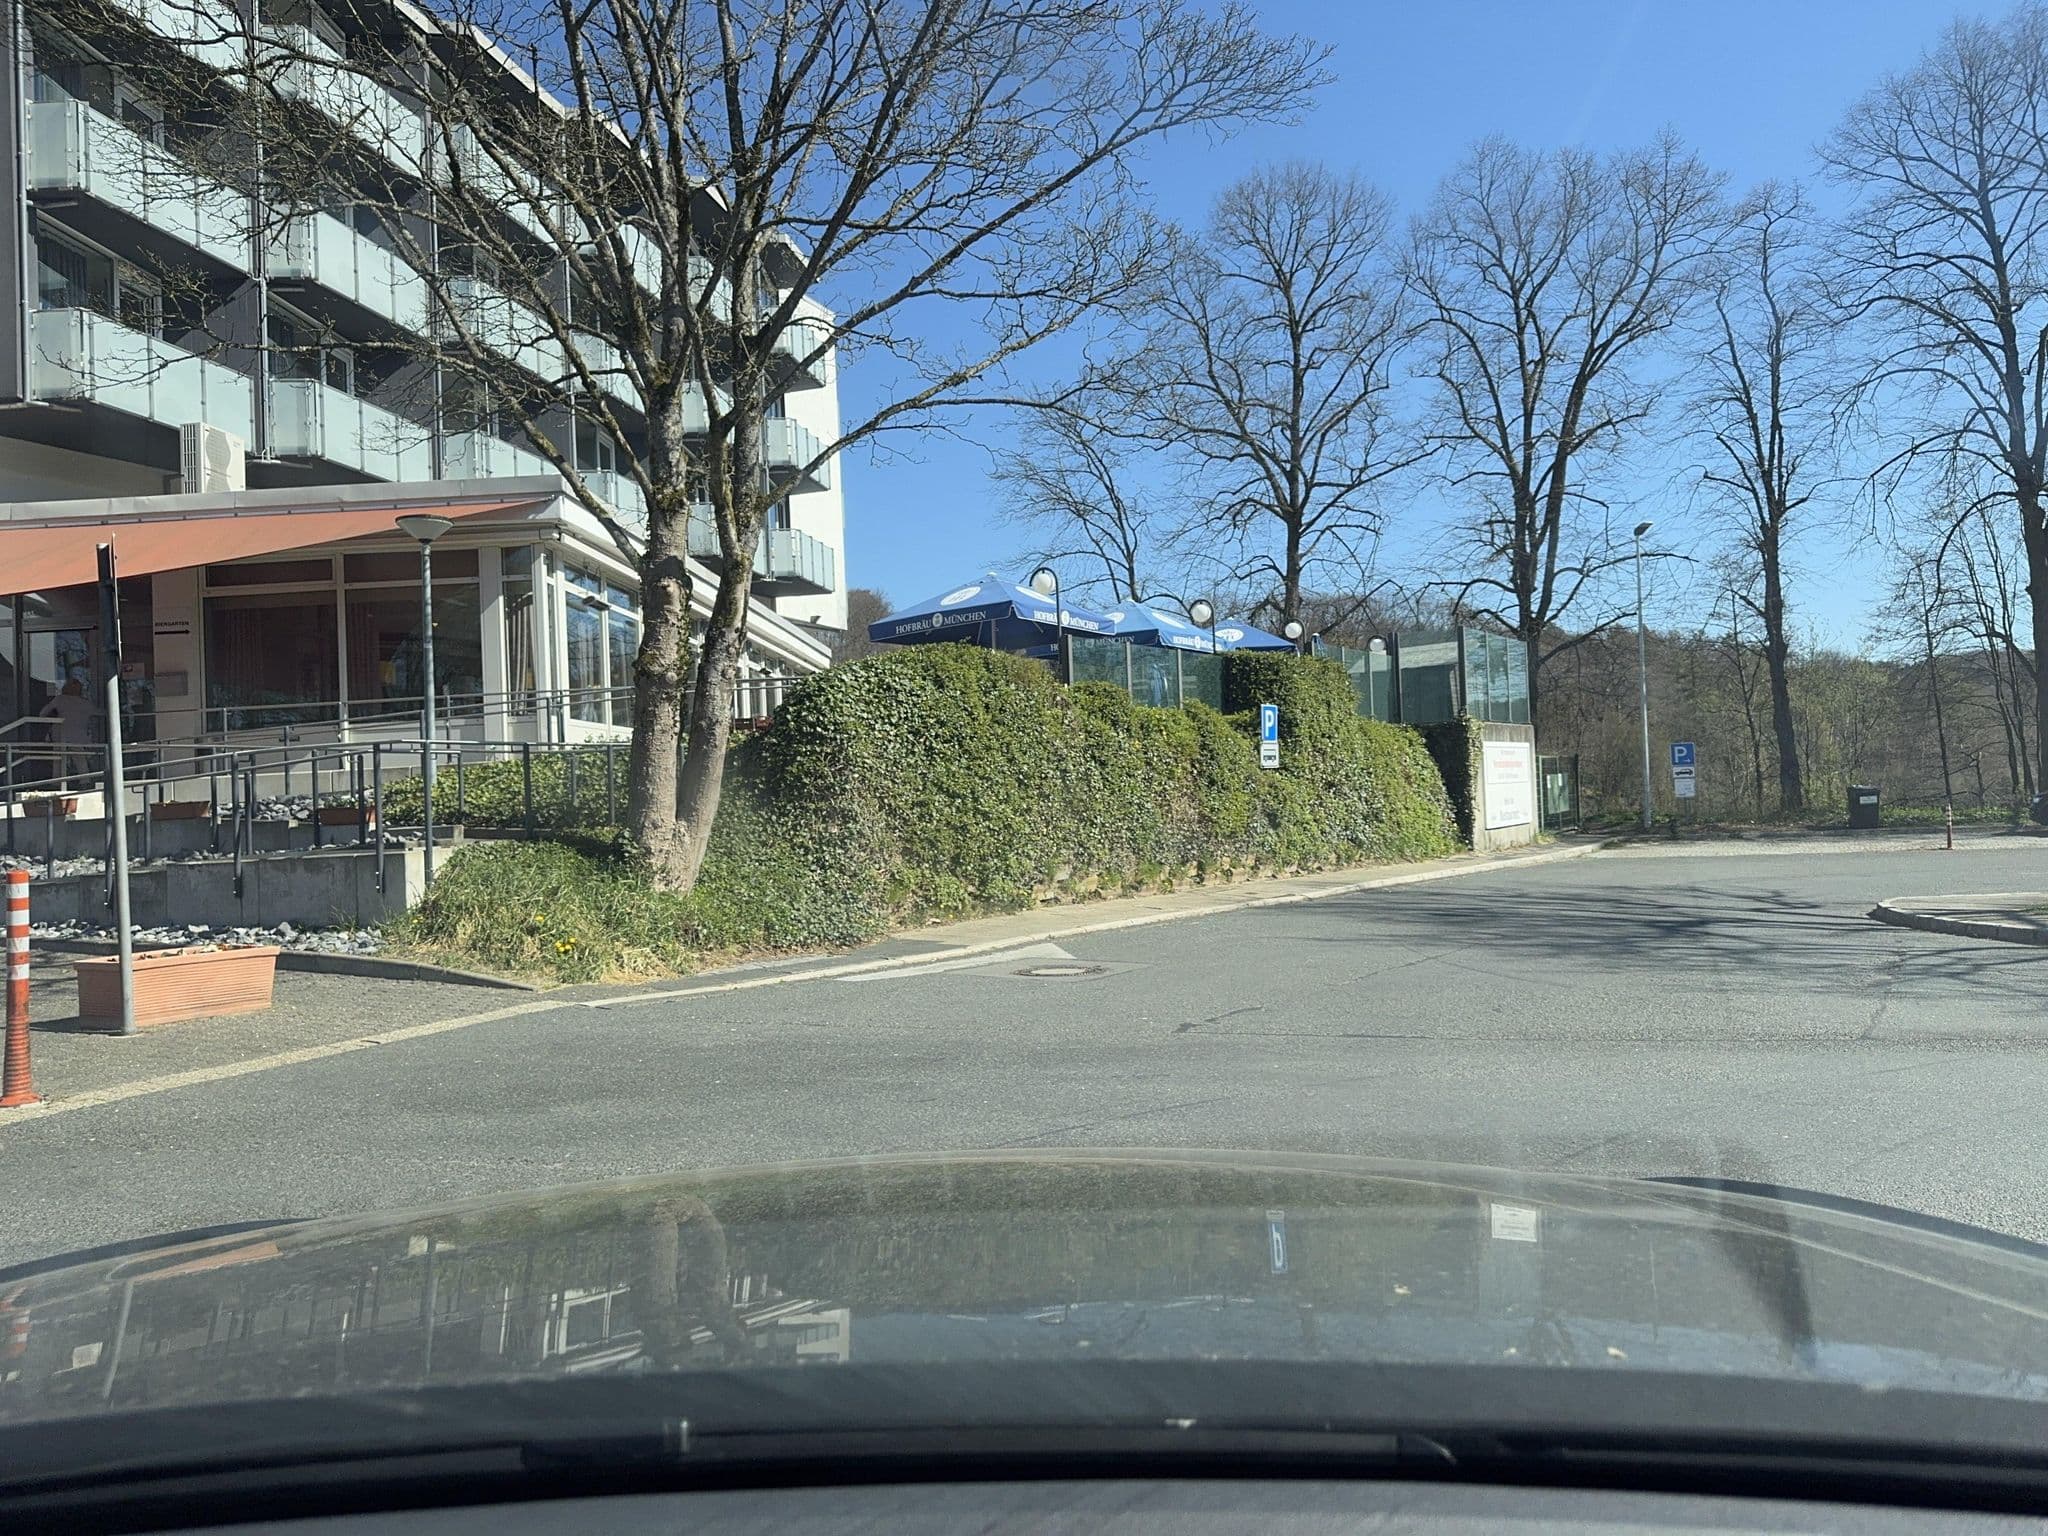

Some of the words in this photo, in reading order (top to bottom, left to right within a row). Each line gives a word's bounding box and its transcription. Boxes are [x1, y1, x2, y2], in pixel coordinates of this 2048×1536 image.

[895, 618, 932, 634] HOFBRÄU
[943, 610, 987, 625] MÜNCHEN
[1069, 617, 1099, 630] MÜNCHEN
[1265, 710, 1275, 737] P
[1674, 746, 1687, 763] P
